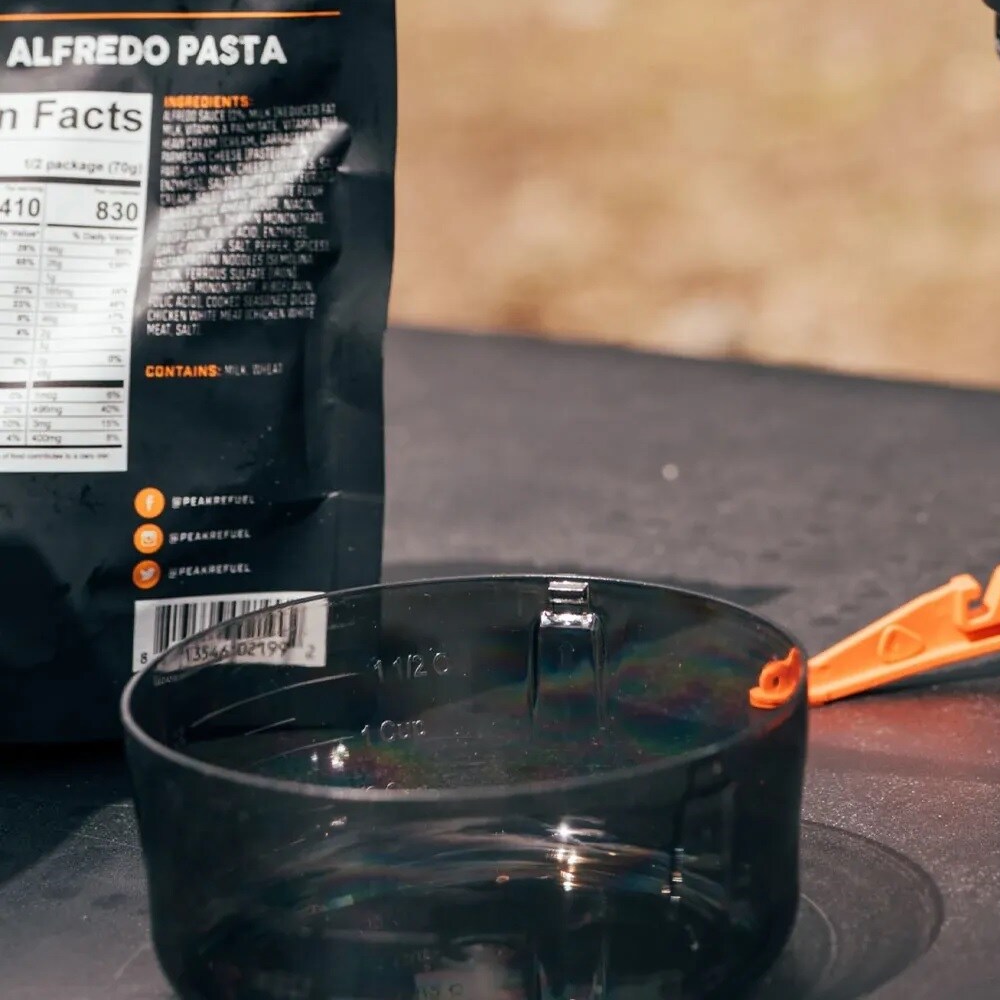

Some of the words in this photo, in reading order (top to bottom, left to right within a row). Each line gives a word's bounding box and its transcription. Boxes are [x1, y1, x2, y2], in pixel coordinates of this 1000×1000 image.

[6, 34, 170, 68] ALFREDO
[177, 34, 288, 66] PASTA
[34, 98, 143, 132] Facts
[46, 159, 104, 174] package
[0, 198, 40, 217] 410
[96, 201, 138, 220] 830
[169, 528, 251, 545] @PEAKREFUEL
[168, 563, 252, 580] @PEAKREFUEL
[140, 652, 149, 665] 8
[305, 645, 316, 659] 2
[433, 651, 449, 676] C
